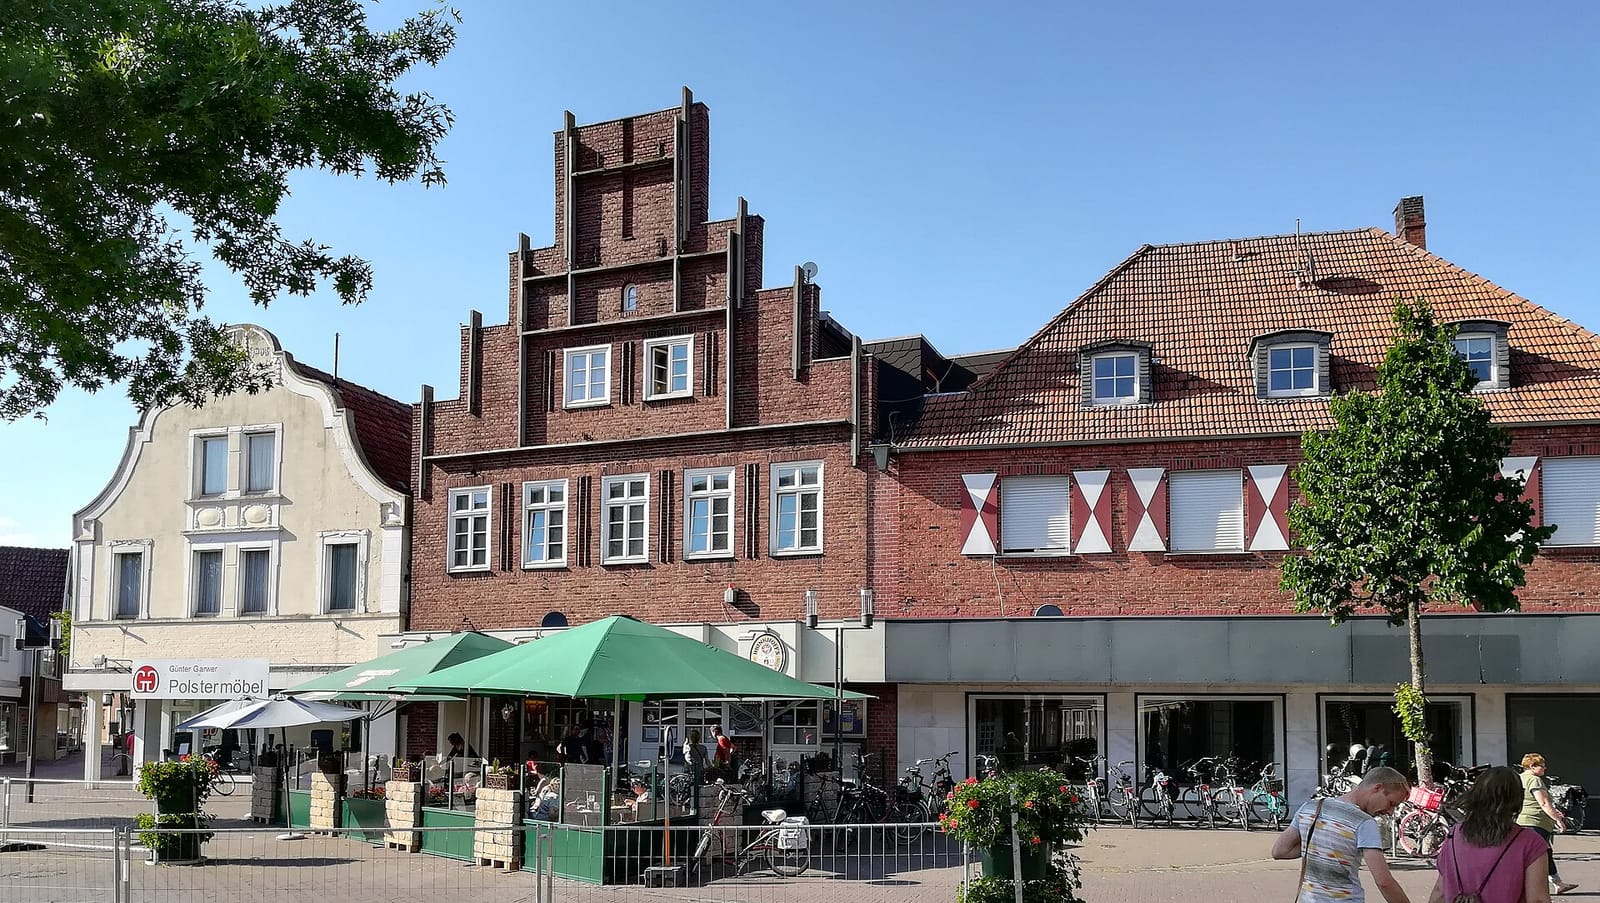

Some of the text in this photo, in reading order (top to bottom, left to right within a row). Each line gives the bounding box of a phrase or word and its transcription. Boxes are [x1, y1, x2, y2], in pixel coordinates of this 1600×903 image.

[169, 665, 218, 673] Günter Garwer
[169, 679, 263, 694] Polstermöbel
